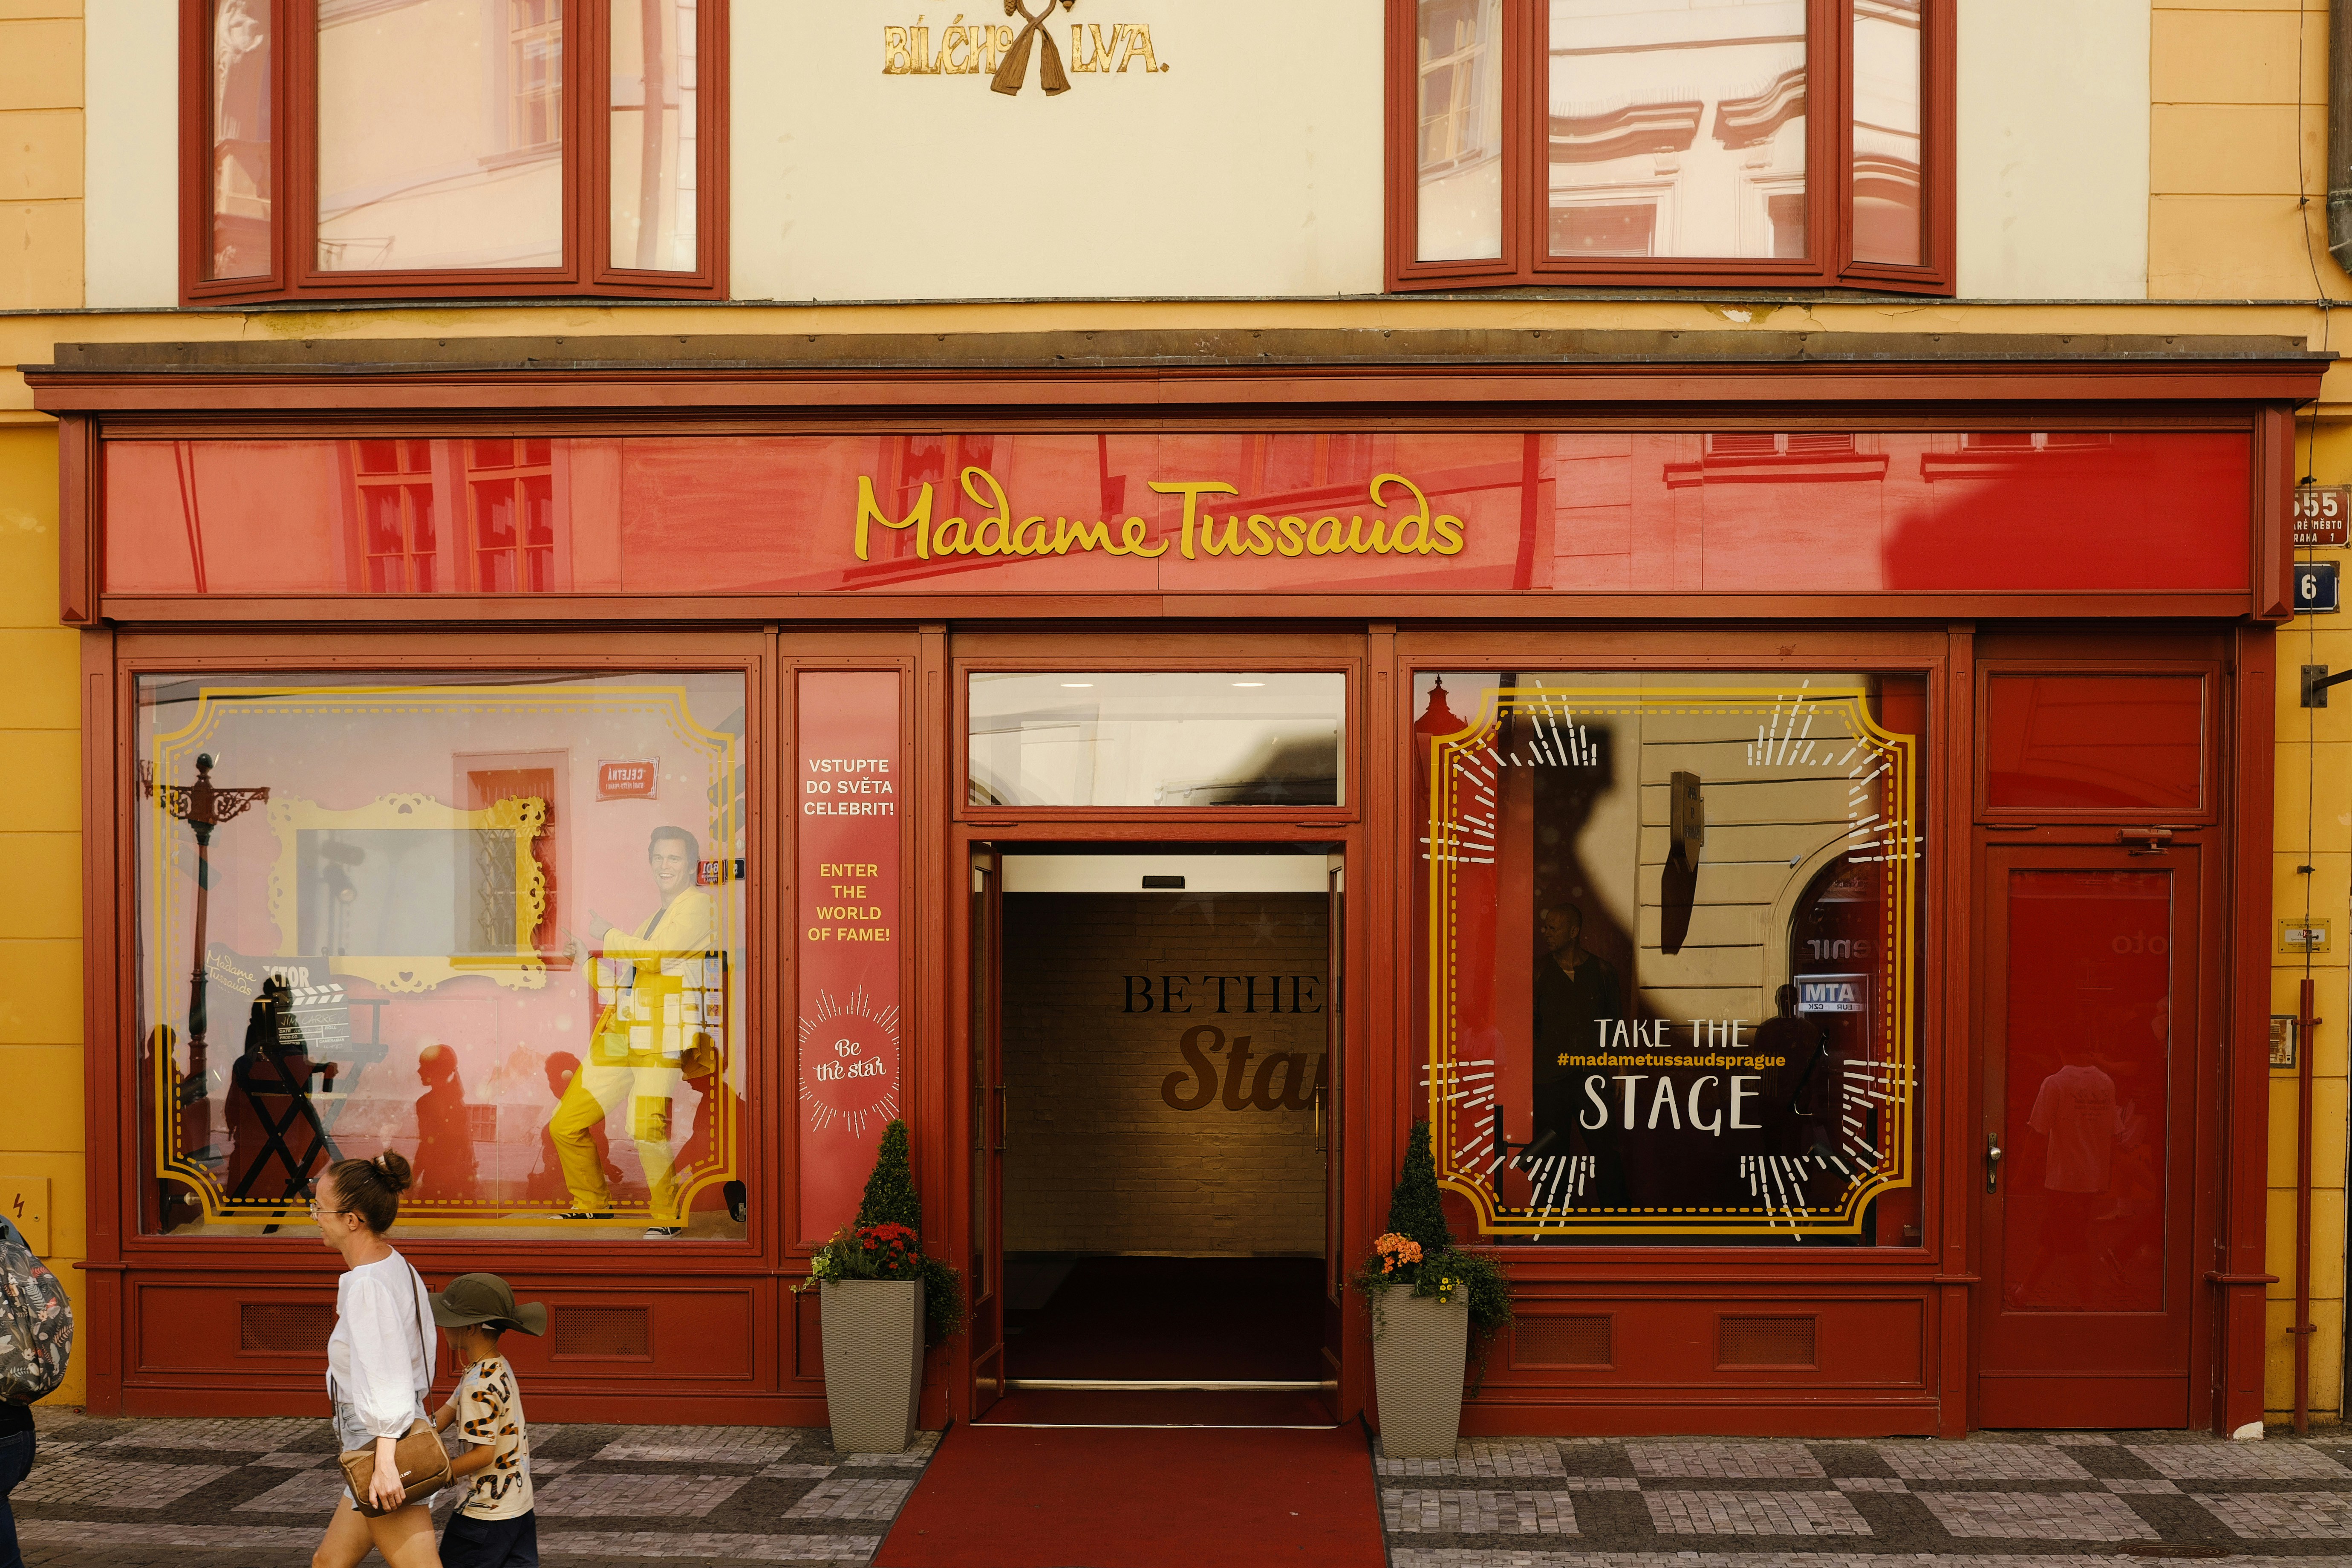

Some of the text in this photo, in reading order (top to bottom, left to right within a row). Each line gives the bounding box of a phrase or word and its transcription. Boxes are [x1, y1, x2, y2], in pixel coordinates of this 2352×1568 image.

[854, 466, 1464, 560] Madame Tussauds
[2294, 518, 2342, 530] RÉ MĚSTO
[2330, 533, 2334, 542] 1
[2301, 574, 2317, 600] 6
[809, 759, 889, 772] VSTUPTE
[806, 776, 893, 794] DO SVĚTA
[804, 802, 894, 815] CELEBRIT!
[820, 864, 878, 877] ENTER
[831, 885, 866, 898] THE
[816, 906, 882, 920] WORLD
[808, 928, 890, 941] OF FAME!
[206, 950, 257, 982] Madame
[205, 964, 252, 996] Tussauds
[1121, 976, 1322, 1013] BE THE
[281, 1013, 346, 1026] JIM CARREY
[1593, 1019, 1749, 1048] TAKE THE
[834, 1039, 862, 1058] Be
[812, 1056, 887, 1081] the star
[1557, 1052, 1786, 1070] #madametussaudsprague
[1579, 1074, 1762, 1137] STAGE
